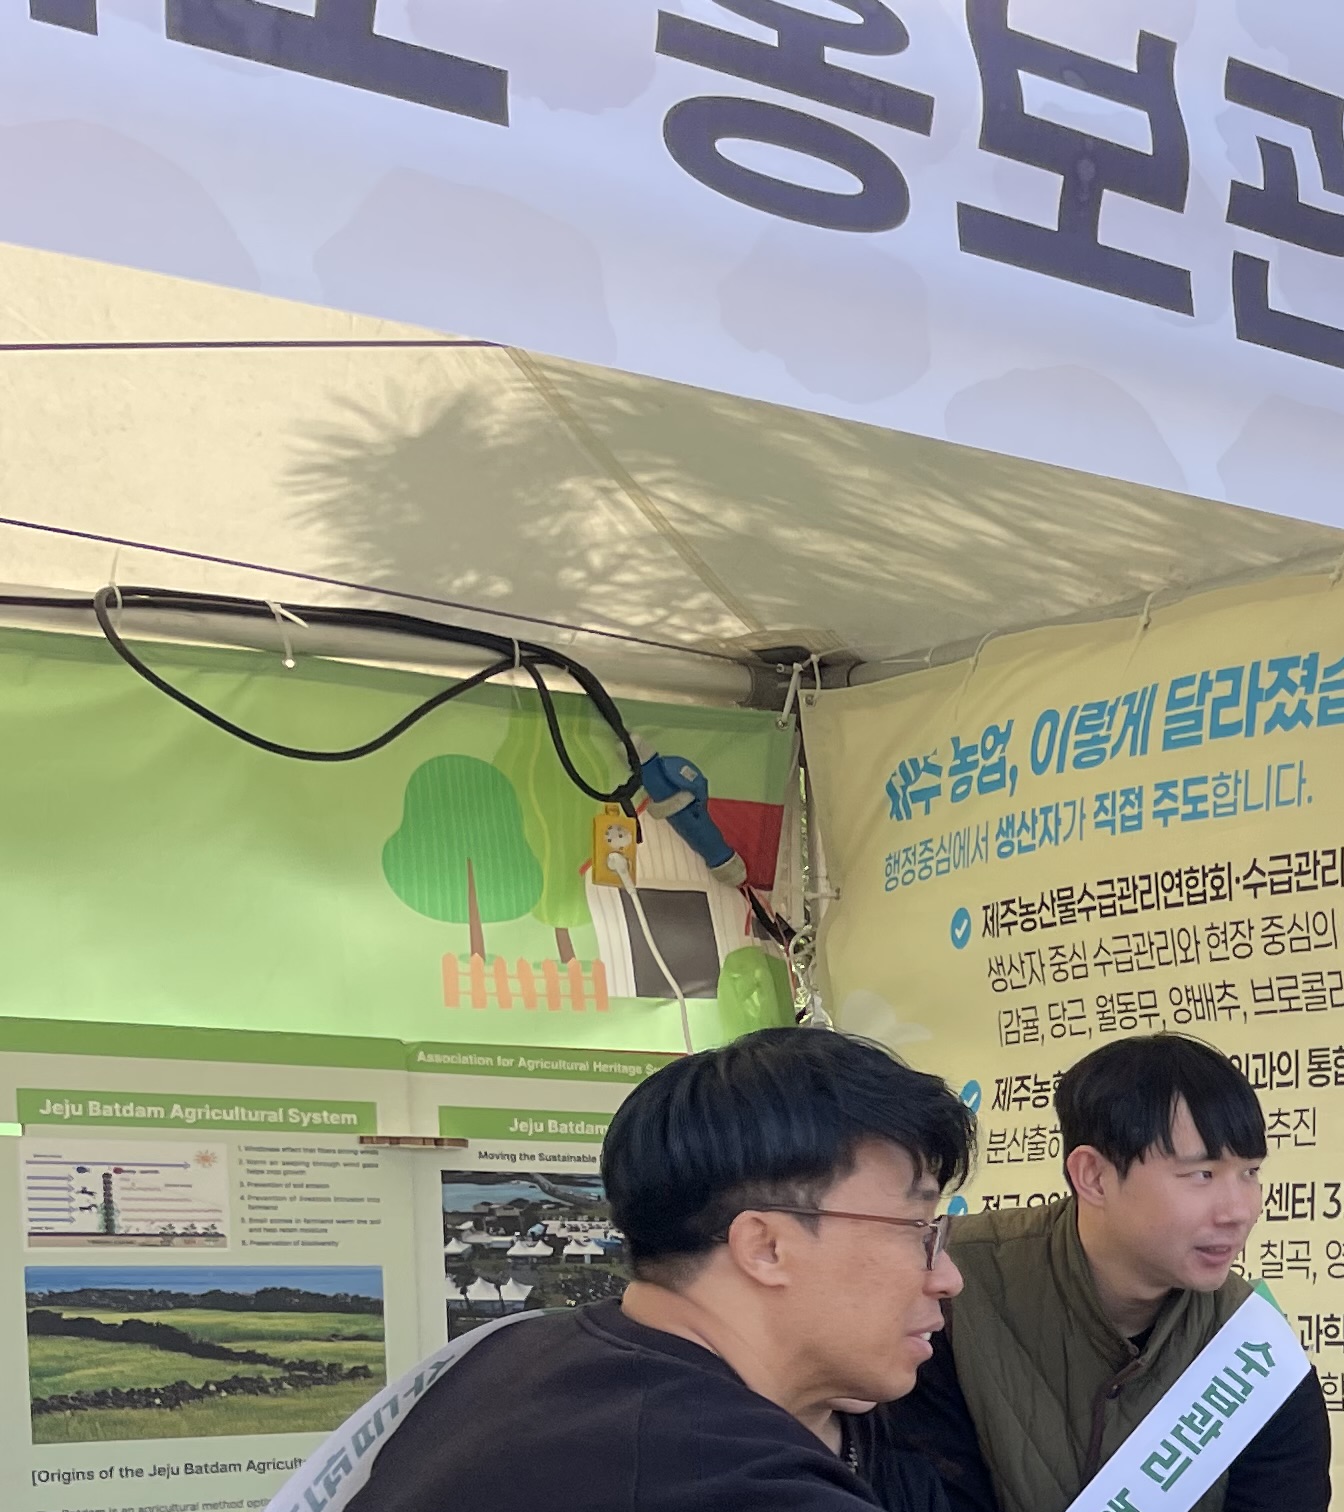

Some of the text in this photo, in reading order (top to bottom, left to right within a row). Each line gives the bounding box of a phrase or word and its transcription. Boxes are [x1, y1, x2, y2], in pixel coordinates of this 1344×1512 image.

[948, 718, 1019, 798] 농업,
[1029, 682, 1160, 777] 이렇게
[884, 759, 1314, 893] 행정중심에서 생산자가 직접 주도합니다.
[987, 948, 1047, 994] 생산자
[1048, 939, 1090, 984] 중심
[1092, 924, 1201, 977] 수급관리와
[1204, 917, 1255, 963] 현장
[1259, 906, 1339, 957] 중심의
[997, 1006, 1045, 1048] (감귤,
[1047, 998, 1093, 1041] 당근,
[1095, 987, 1167, 1032] 월동무,
[1168, 978, 1249, 1026] 양배추,
[417, 1051, 494, 1067] Association
[497, 1055, 514, 1067] for
[517, 1056, 590, 1072] Agricultural
[592, 1061, 643, 1077] Heritage
[40, 1099, 358, 1128] Jeju Batdam Agricultural System
[509, 1117, 609, 1137] Jeju Batdam
[1266, 1105, 1317, 1150] 추진
[478, 1150, 597, 1164] Moving the Sustainable
[1260, 1180, 1316, 1223] 센터
[1259, 1238, 1318, 1286] 칠곡,
[1138, 1340, 1277, 1493] 수급관리
[32, 1469, 96, 1488] [Origins
[99, 1466, 115, 1480] of
[118, 1466, 144, 1479] the
[148, 1463, 180, 1480] Jeju
[183, 1460, 243, 1475] Batdam
